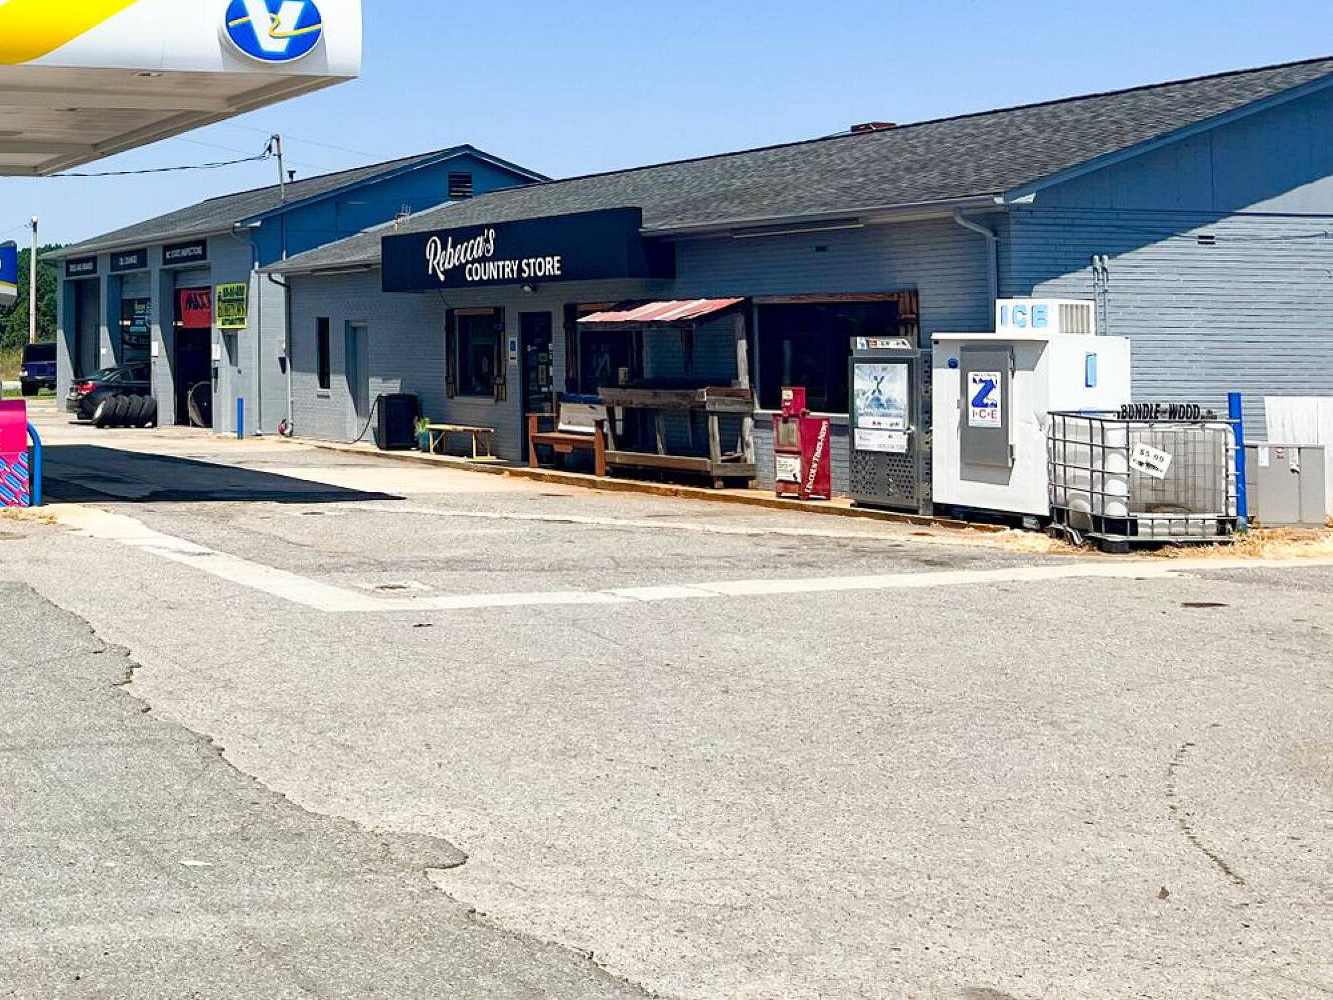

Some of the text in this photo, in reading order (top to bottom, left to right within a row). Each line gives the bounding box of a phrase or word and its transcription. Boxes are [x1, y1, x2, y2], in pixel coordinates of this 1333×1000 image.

[426, 228, 495, 282] Rebecca's
[466, 256, 562, 281] COUNTRY STORE
[1001, 304, 1049, 328] ICE
[1121, 404, 1160, 420] BUNDLE
[1169, 404, 1200, 420] WOOD
